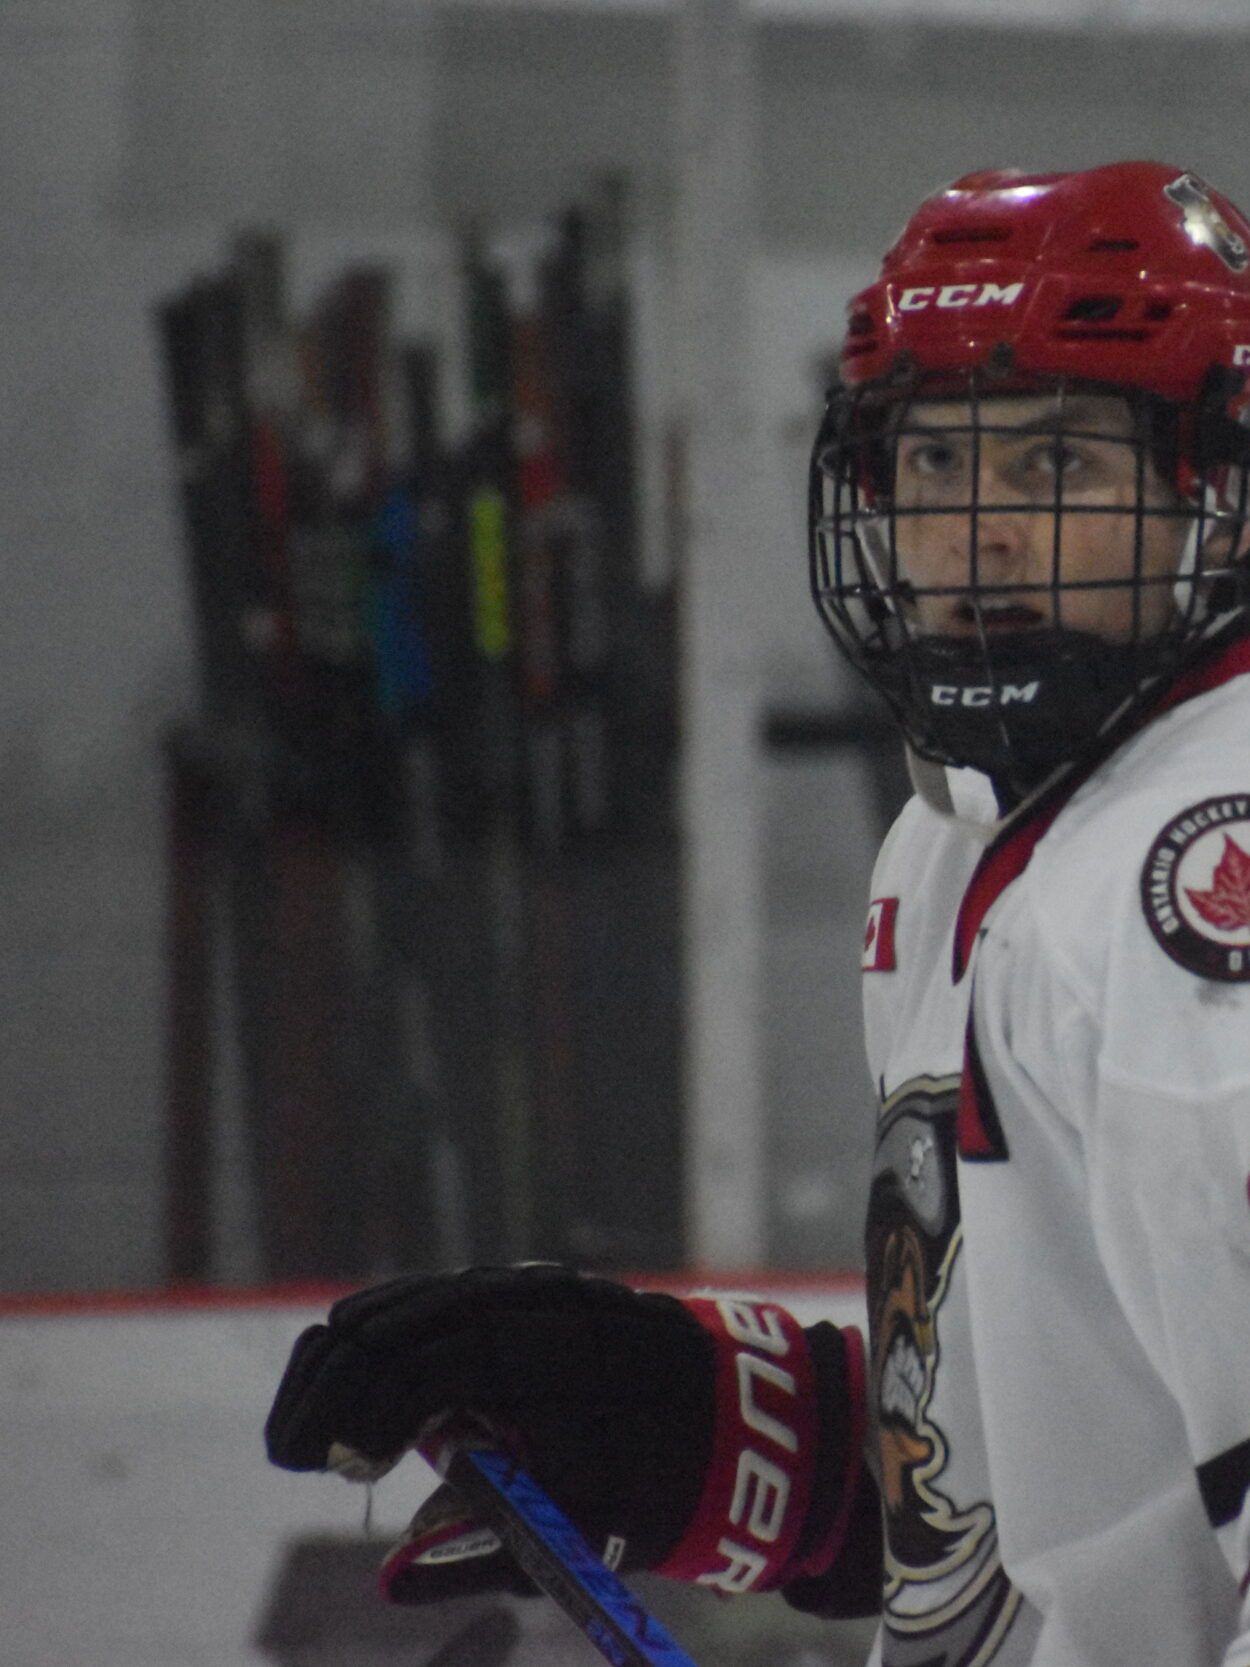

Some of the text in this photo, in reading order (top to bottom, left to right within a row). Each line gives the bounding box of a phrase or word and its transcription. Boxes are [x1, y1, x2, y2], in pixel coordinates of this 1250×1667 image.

[898, 282, 1026, 311] CCM
[930, 680, 1041, 706] CCM
[1150, 848, 1180, 935] ONTARIO
[1170, 800, 1249, 847] HOCKEY
[694, 1287, 800, 1594] AUER
